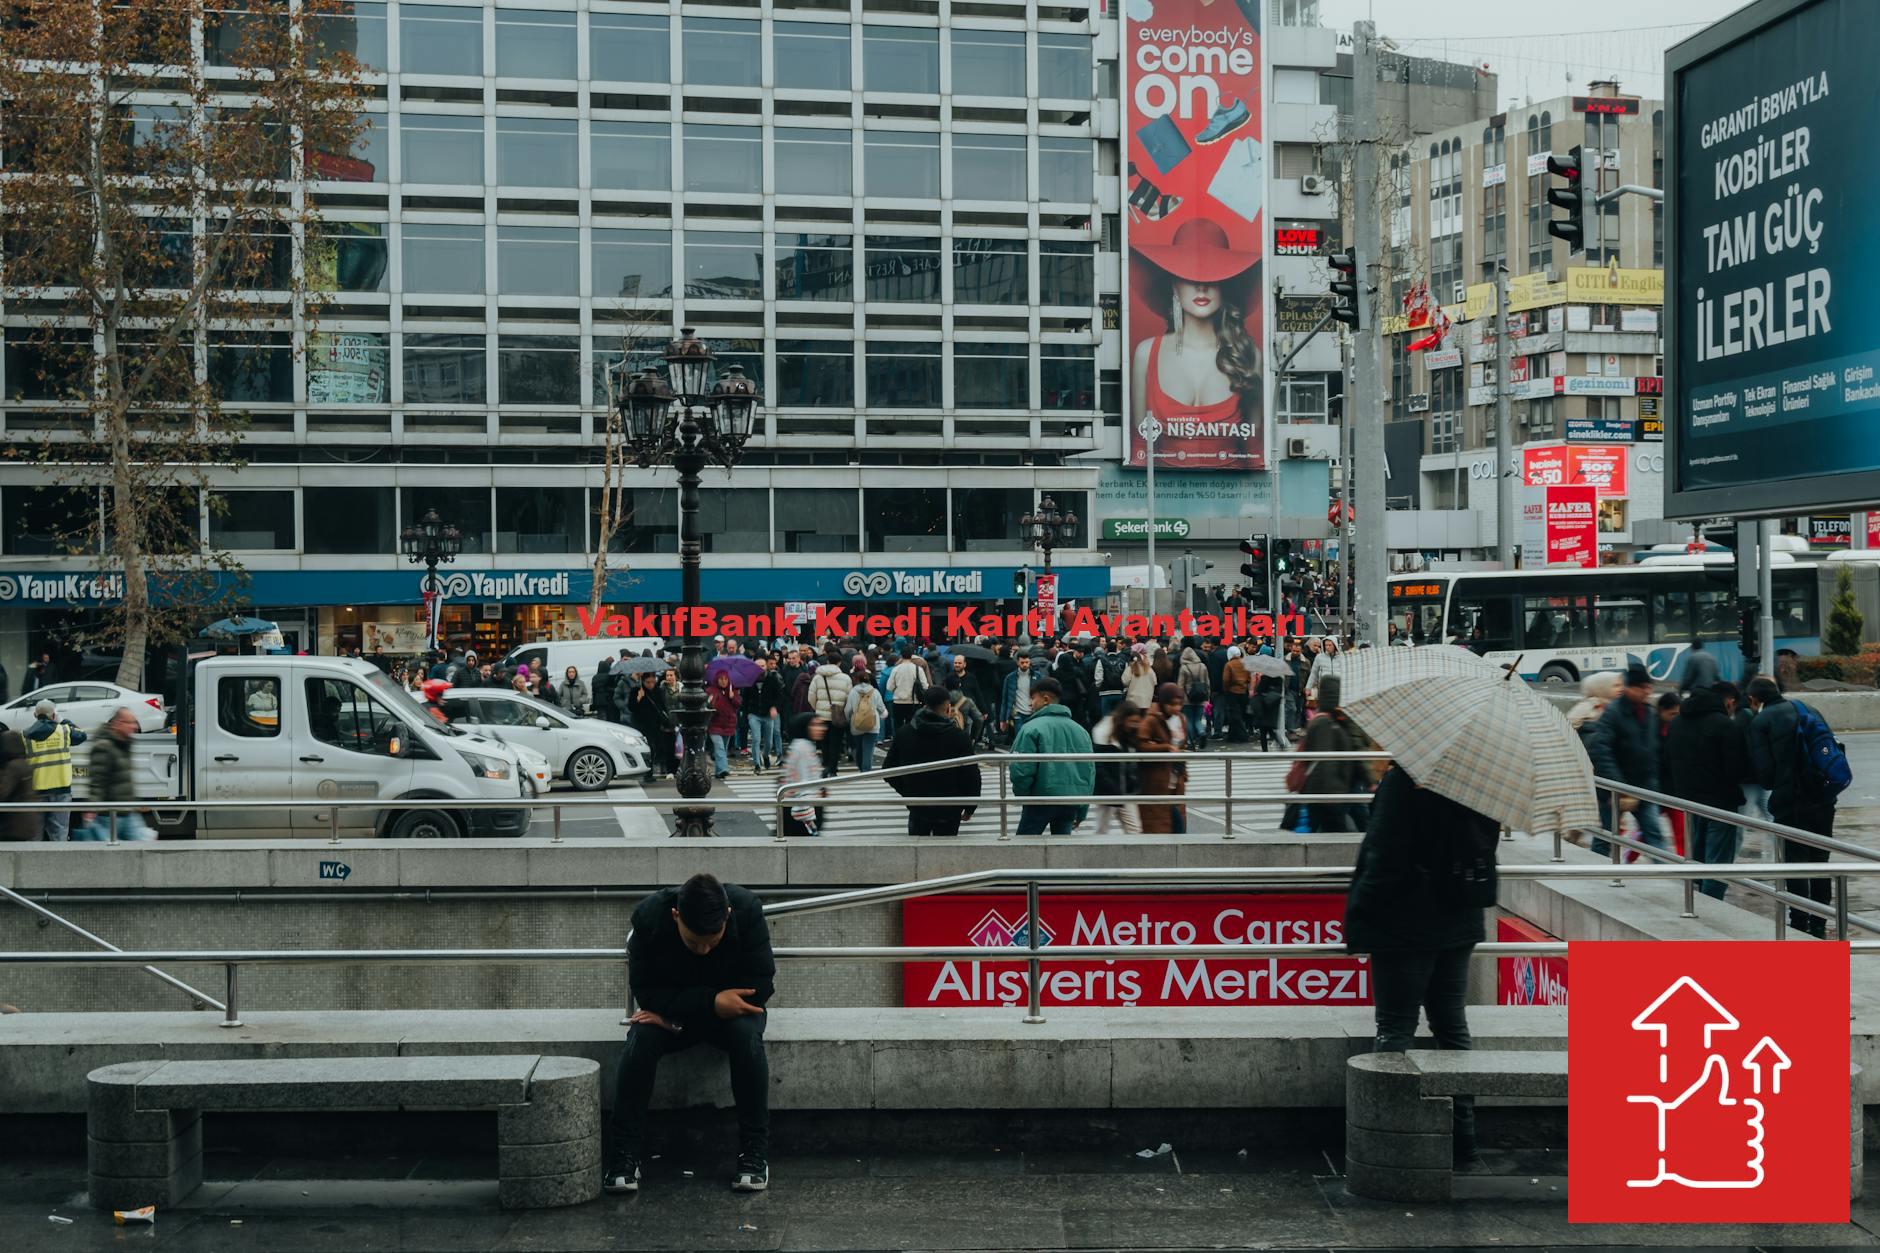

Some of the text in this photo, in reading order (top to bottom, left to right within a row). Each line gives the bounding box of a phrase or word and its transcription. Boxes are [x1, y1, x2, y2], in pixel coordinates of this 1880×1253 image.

[1139, 25, 1253, 49] everybody's
[1136, 44, 1253, 75] come
[1135, 73, 1220, 119] on
[1701, 71, 1829, 149] GARANTİ BBVA'YLA
[1715, 126, 1810, 200] KOBİ'LER
[1277, 229, 1317, 241] LOVE
[1703, 182, 1824, 273] TAM GÜÇ
[1277, 242, 1317, 254] SHOP
[1576, 273, 1606, 289] CITI
[1620, 275, 1664, 293] Englis
[1697, 267, 1832, 362] İLERLER
[1569, 378, 1630, 391] gezinomi
[1783, 375, 1812, 394] Finansal
[1844, 366, 1873, 385] Girişim
[1783, 394, 1810, 412] Ürünleri
[1472, 458, 1519, 479] COLS
[1636, 455, 1664, 472] CO
[1099, 480, 1134, 488] kerbank
[1549, 502, 1592, 513] ZAFER
[892, 571, 982, 596] Yapı Kredi
[322, 863, 345, 878] WC
[1071, 909, 1197, 945] Metro
[1160, 957, 1368, 1001] Merkezi
